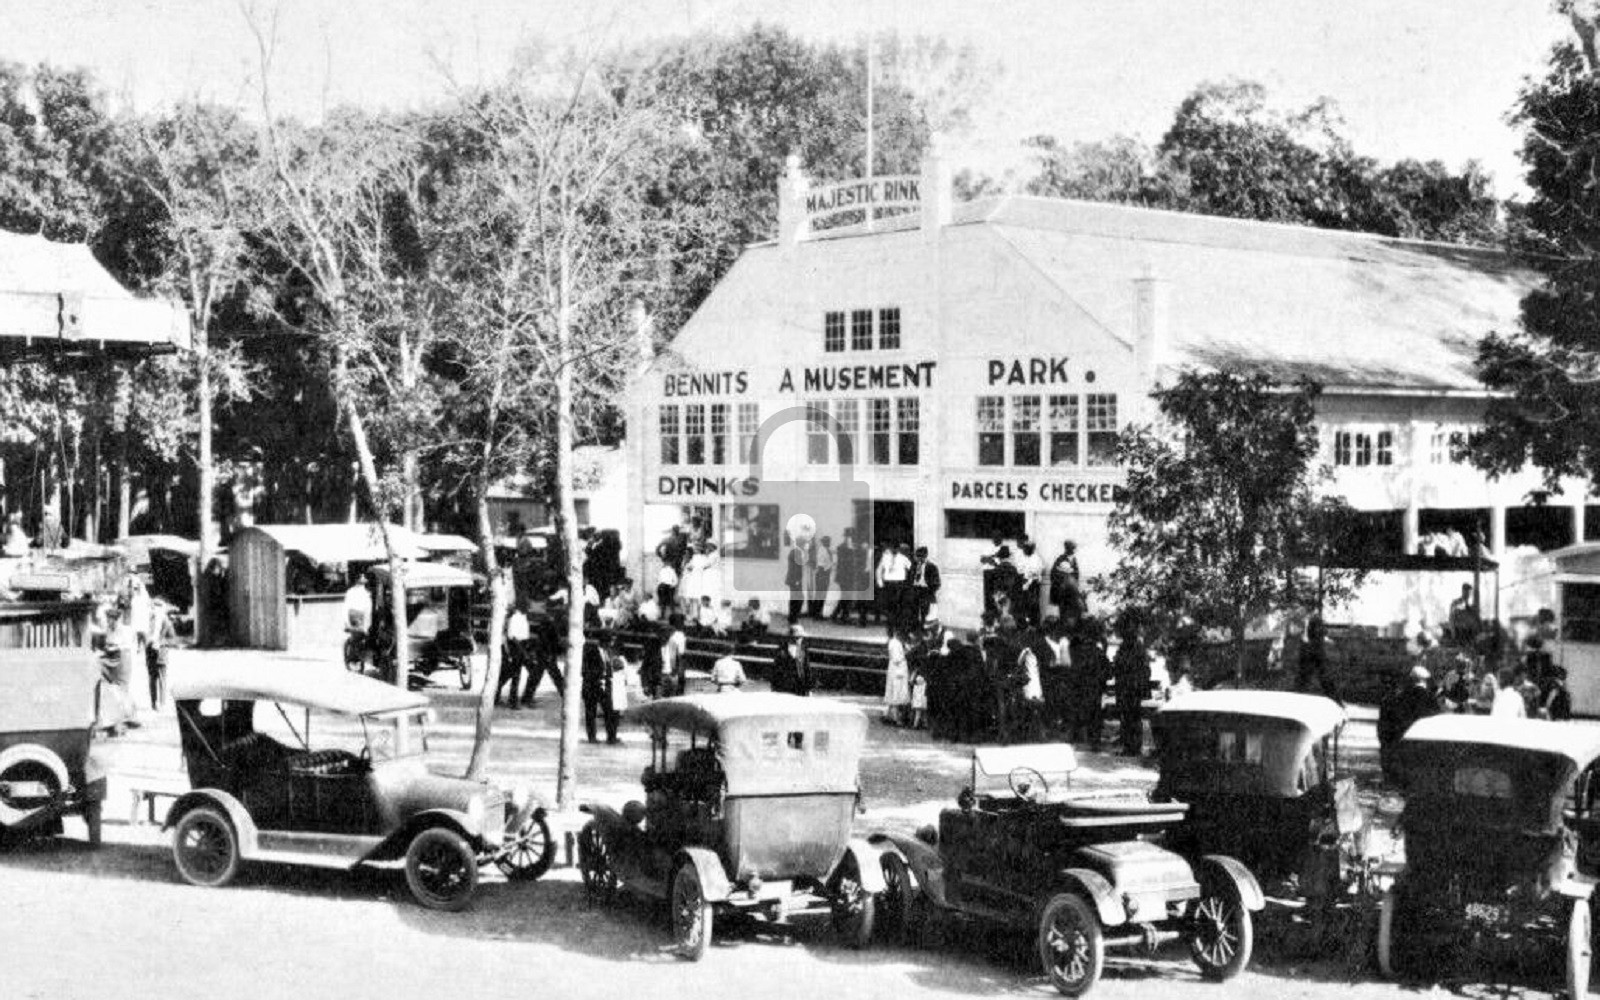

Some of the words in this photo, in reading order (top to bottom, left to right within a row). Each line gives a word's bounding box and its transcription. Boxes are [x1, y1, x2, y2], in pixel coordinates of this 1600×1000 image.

[806, 182, 878, 214] MAJESTIC
[884, 180, 921, 201] RINK
[664, 371, 748, 397] BENNITS
[659, 476, 759, 496] DRINKS
[952, 481, 1028, 500] PARCELS
